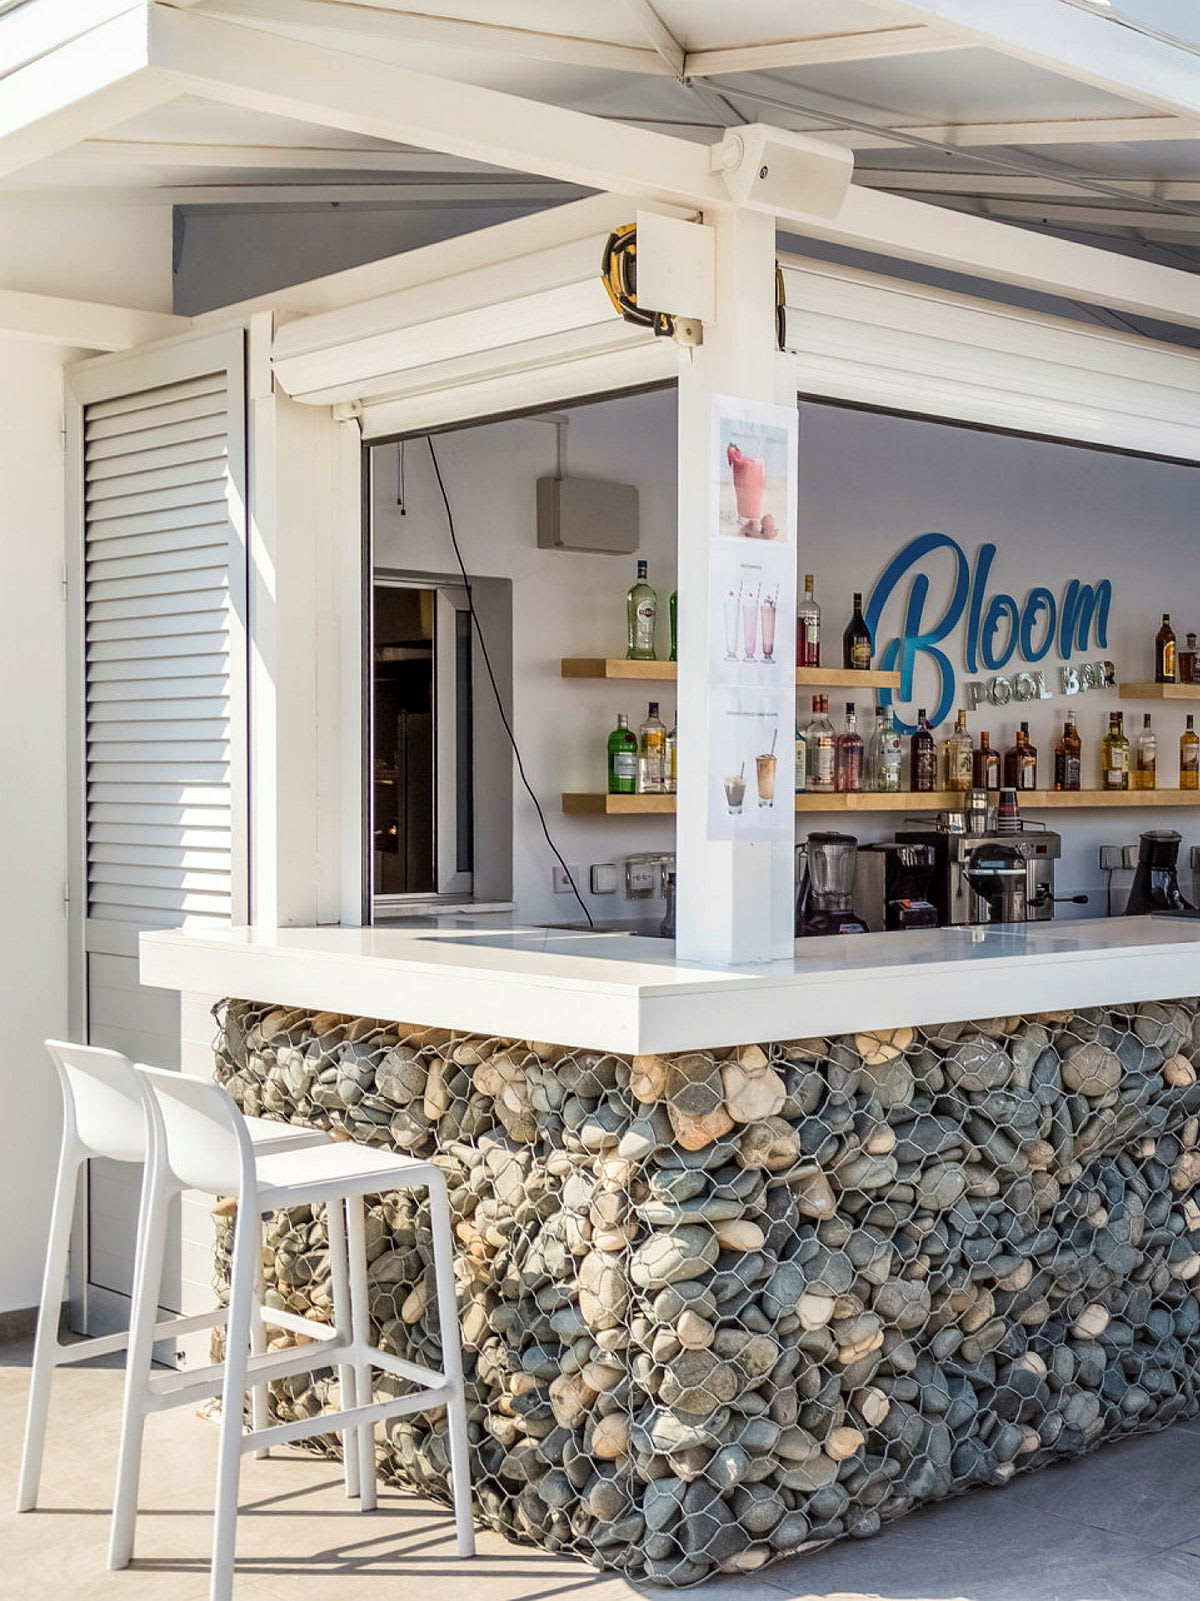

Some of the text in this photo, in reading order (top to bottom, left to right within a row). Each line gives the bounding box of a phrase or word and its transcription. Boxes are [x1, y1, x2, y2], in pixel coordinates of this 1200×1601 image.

[864, 532, 1112, 735] Bloom
[965, 660, 1118, 711] POOL BAR
